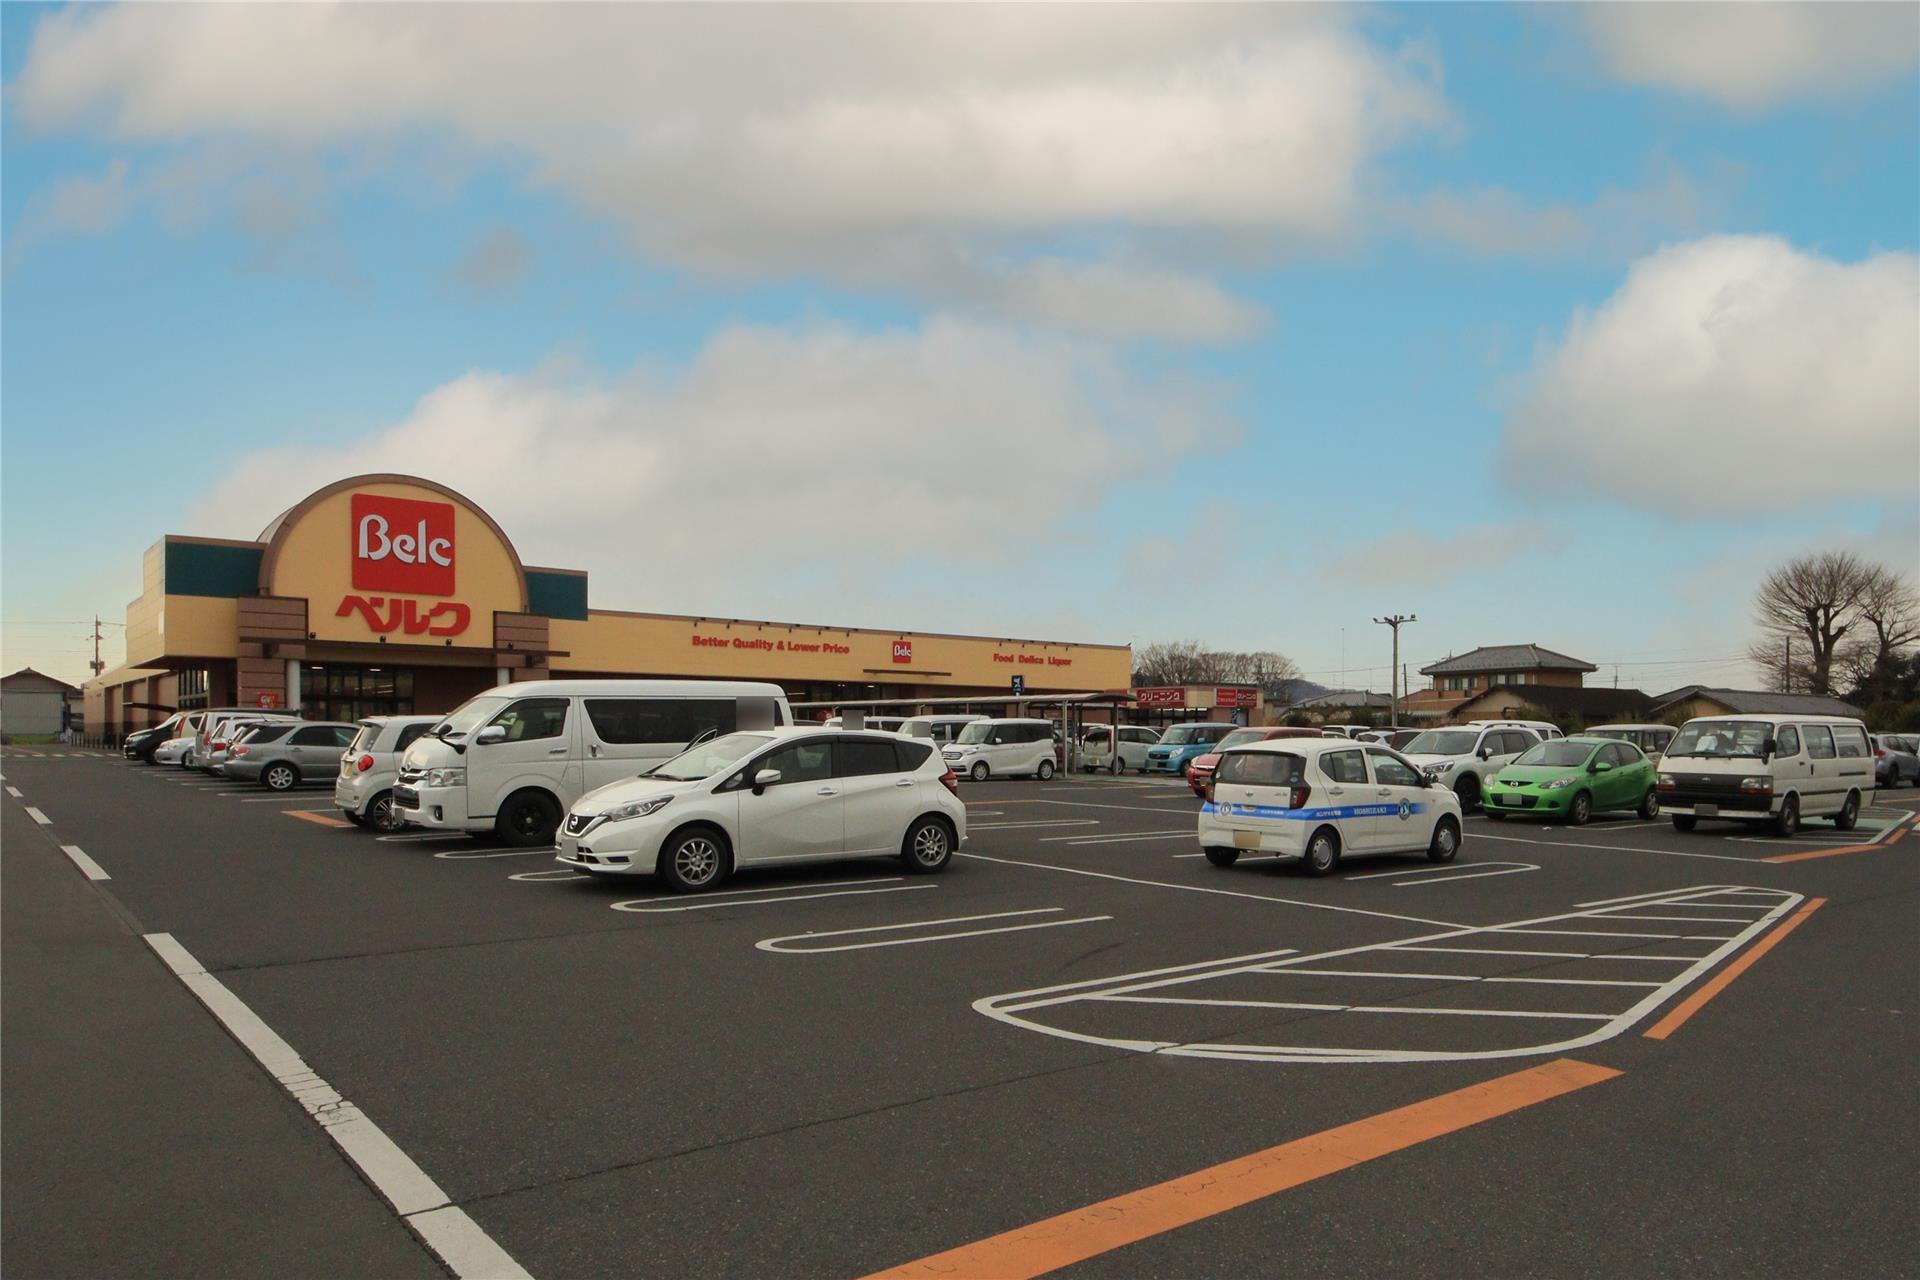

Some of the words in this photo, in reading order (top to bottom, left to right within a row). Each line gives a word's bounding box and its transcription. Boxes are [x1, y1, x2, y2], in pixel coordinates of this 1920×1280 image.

[358, 514, 452, 567] Belc
[335, 595, 471, 637] ベルク
[692, 636, 730, 648] Better
[733, 638, 774, 651] Quality
[777, 641, 785, 650] &
[787, 641, 821, 653] Lower
[823, 643, 850, 654] Price
[894, 645, 911, 657] Belc
[993, 653, 1014, 663] Food
[1018, 655, 1044, 665] Delica
[1048, 657, 1072, 666] Liquor
[1140, 692, 1180, 701] クリーニング
